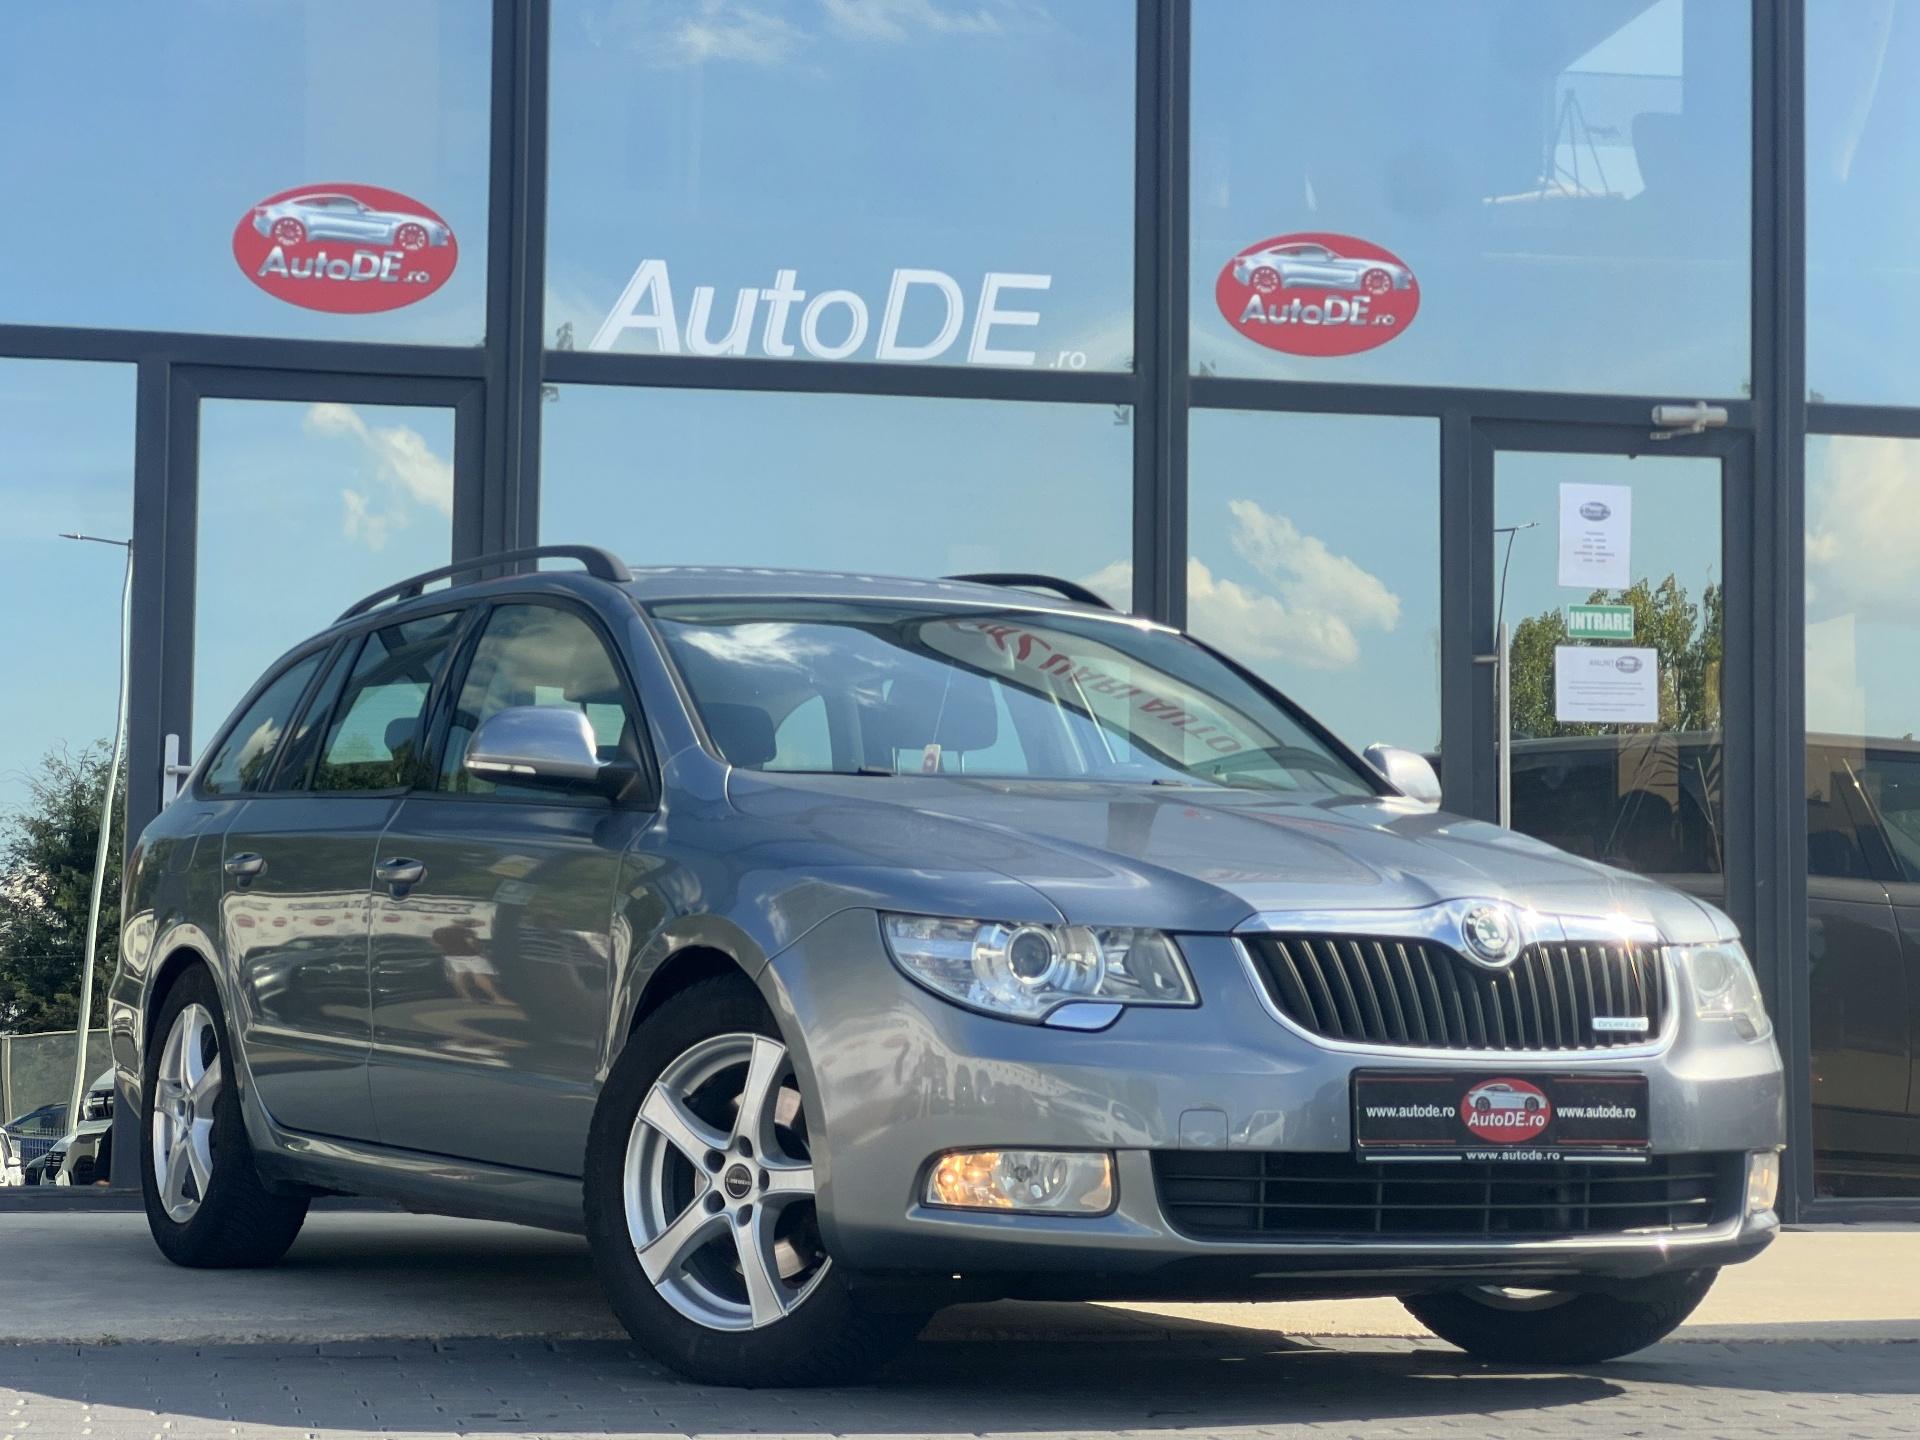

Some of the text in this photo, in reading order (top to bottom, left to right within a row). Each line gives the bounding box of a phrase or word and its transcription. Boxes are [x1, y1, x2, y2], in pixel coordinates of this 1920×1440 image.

[1570, 611, 1631, 631] INTRARE
[1366, 1104, 1456, 1118] www.autode.ro
[1556, 1106, 1637, 1119] www.autode.ro
[1467, 1111, 1546, 1127] AutoDE.ro
[1466, 1151, 1561, 1161] www.autode.ro
